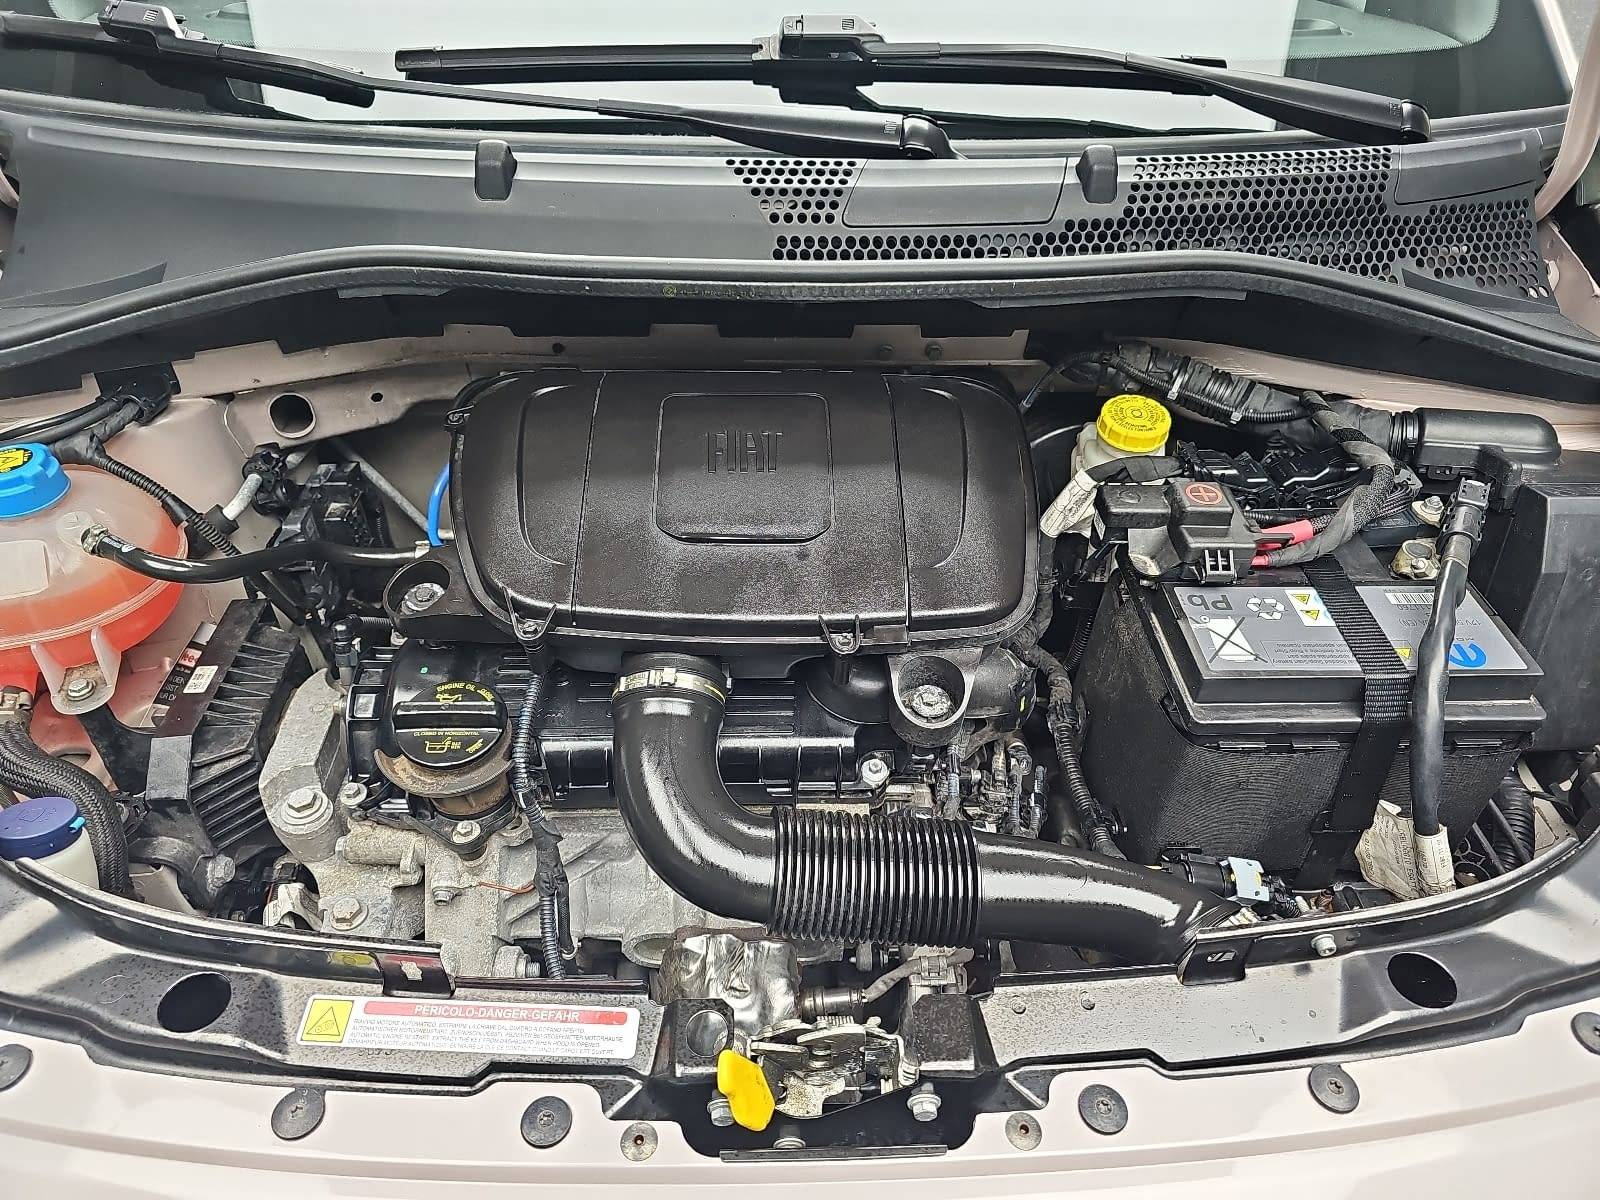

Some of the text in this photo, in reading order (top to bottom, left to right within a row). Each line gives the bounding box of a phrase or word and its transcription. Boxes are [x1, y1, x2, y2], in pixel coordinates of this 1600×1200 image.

[707, 430, 783, 474] FIAT
[1187, 594, 1233, 611] Pb
[436, 682, 476, 692] ENGINE OIL
[414, 1004, 580, 1022] PERICOLO-DANGER-GEFAHR
